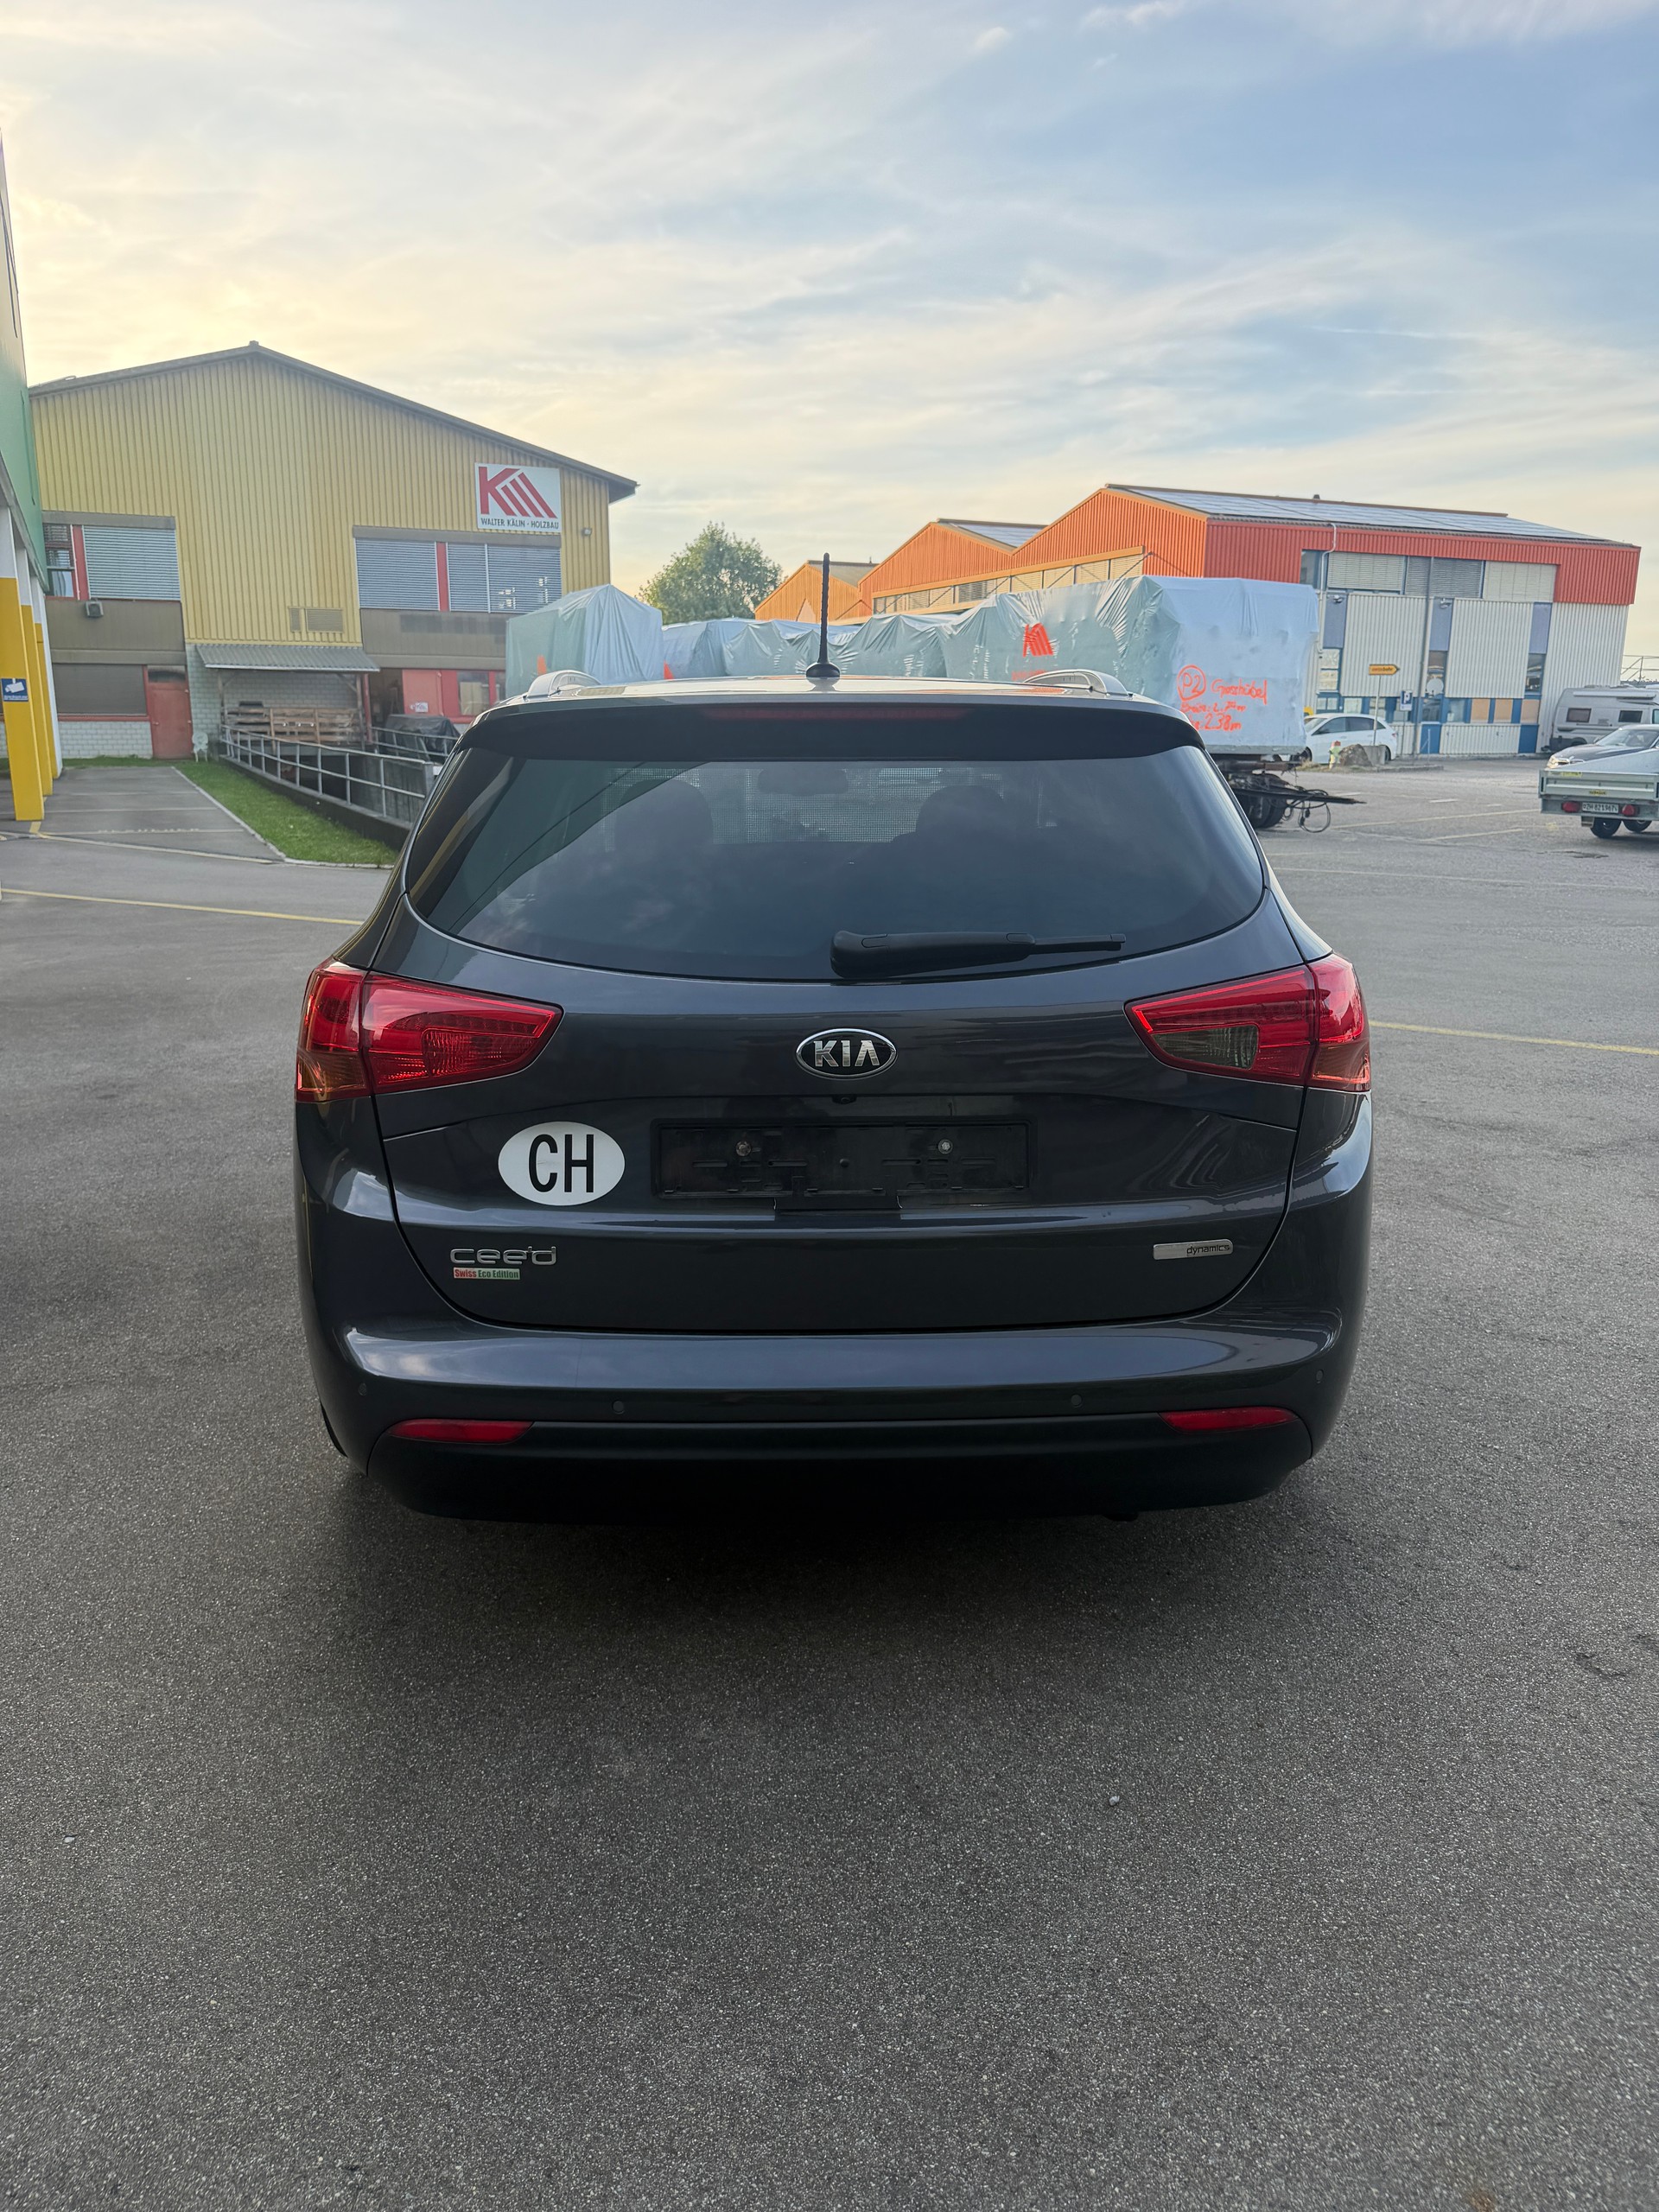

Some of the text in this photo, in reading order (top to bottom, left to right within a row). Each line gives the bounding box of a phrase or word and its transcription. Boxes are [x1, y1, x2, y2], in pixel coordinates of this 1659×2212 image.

[481, 518, 505, 526] WALTER
[507, 518, 525, 528] KÄLIN
[531, 520, 559, 529] HOLZBAU
[813, 1039, 880, 1067] KIA
[529, 1134, 594, 1192] CH
[1186, 1244, 1230, 1255] dynamics
[454, 1269, 519, 1279] Swiss Eco Edition
